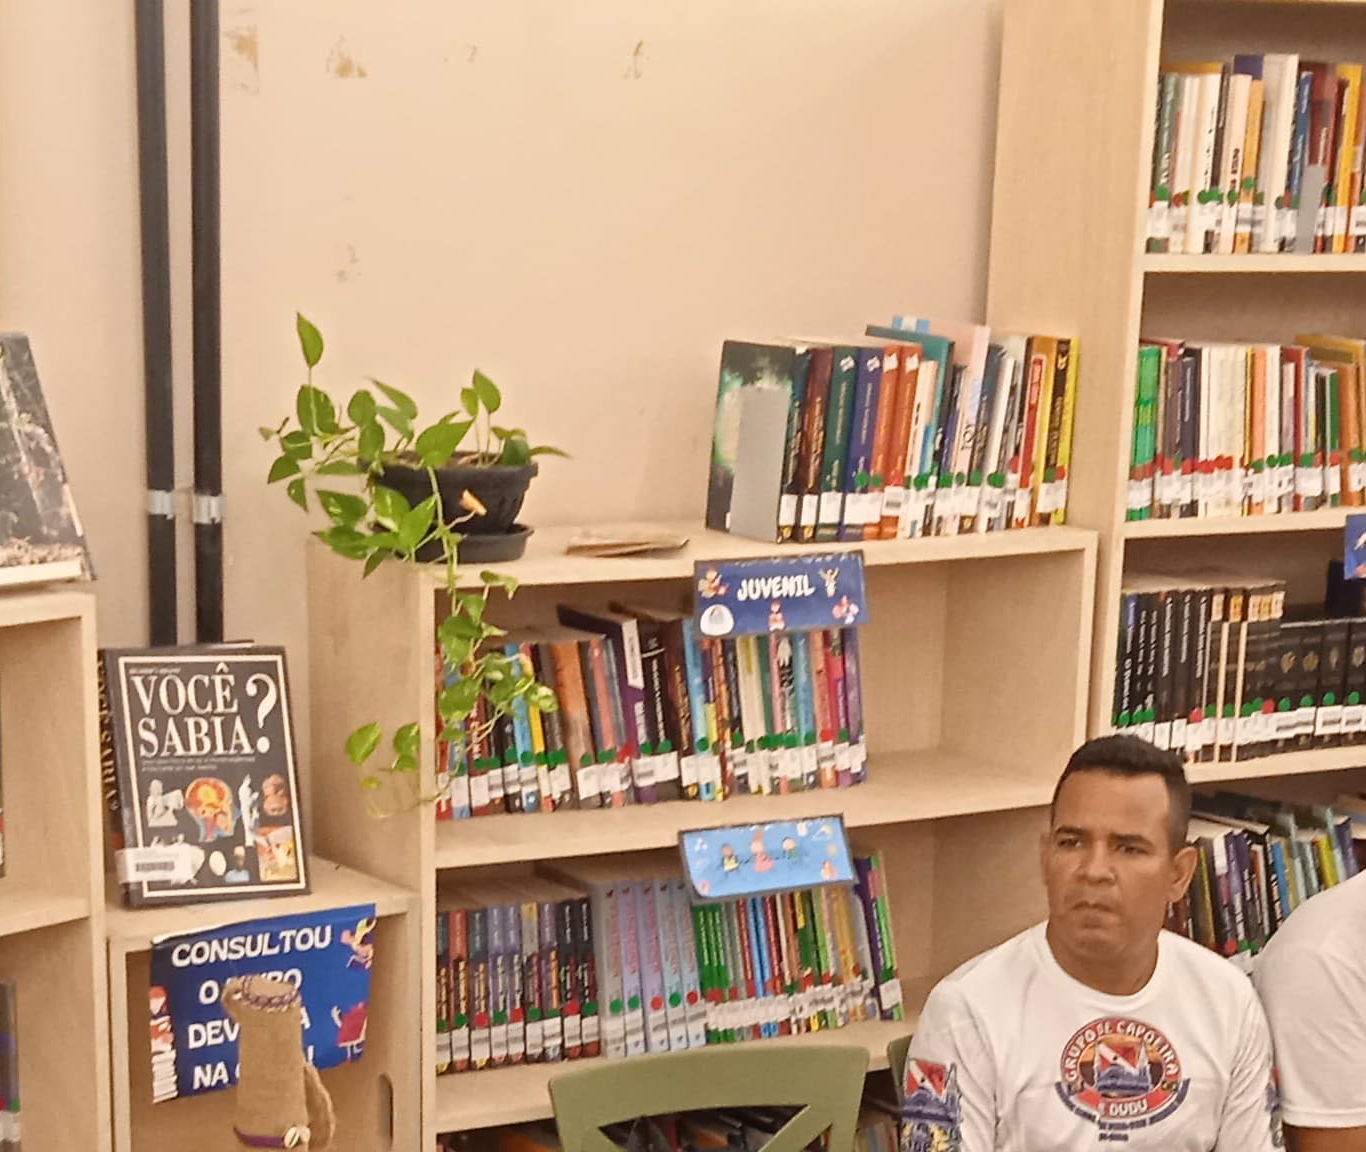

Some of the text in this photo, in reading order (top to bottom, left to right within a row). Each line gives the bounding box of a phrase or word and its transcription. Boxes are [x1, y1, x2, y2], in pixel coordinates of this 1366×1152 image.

[737, 574, 816, 602] JUVENIL
[129, 662, 239, 715] VOCÊ
[172, 925, 333, 968] CONSULTOU
[198, 980, 220, 1006] O
[1065, 1028, 1097, 1081] GRUPO
[1116, 1020, 1180, 1077] CAPOEIRA
[193, 1063, 230, 1091] NA
[1109, 1097, 1148, 1117] DUDU
